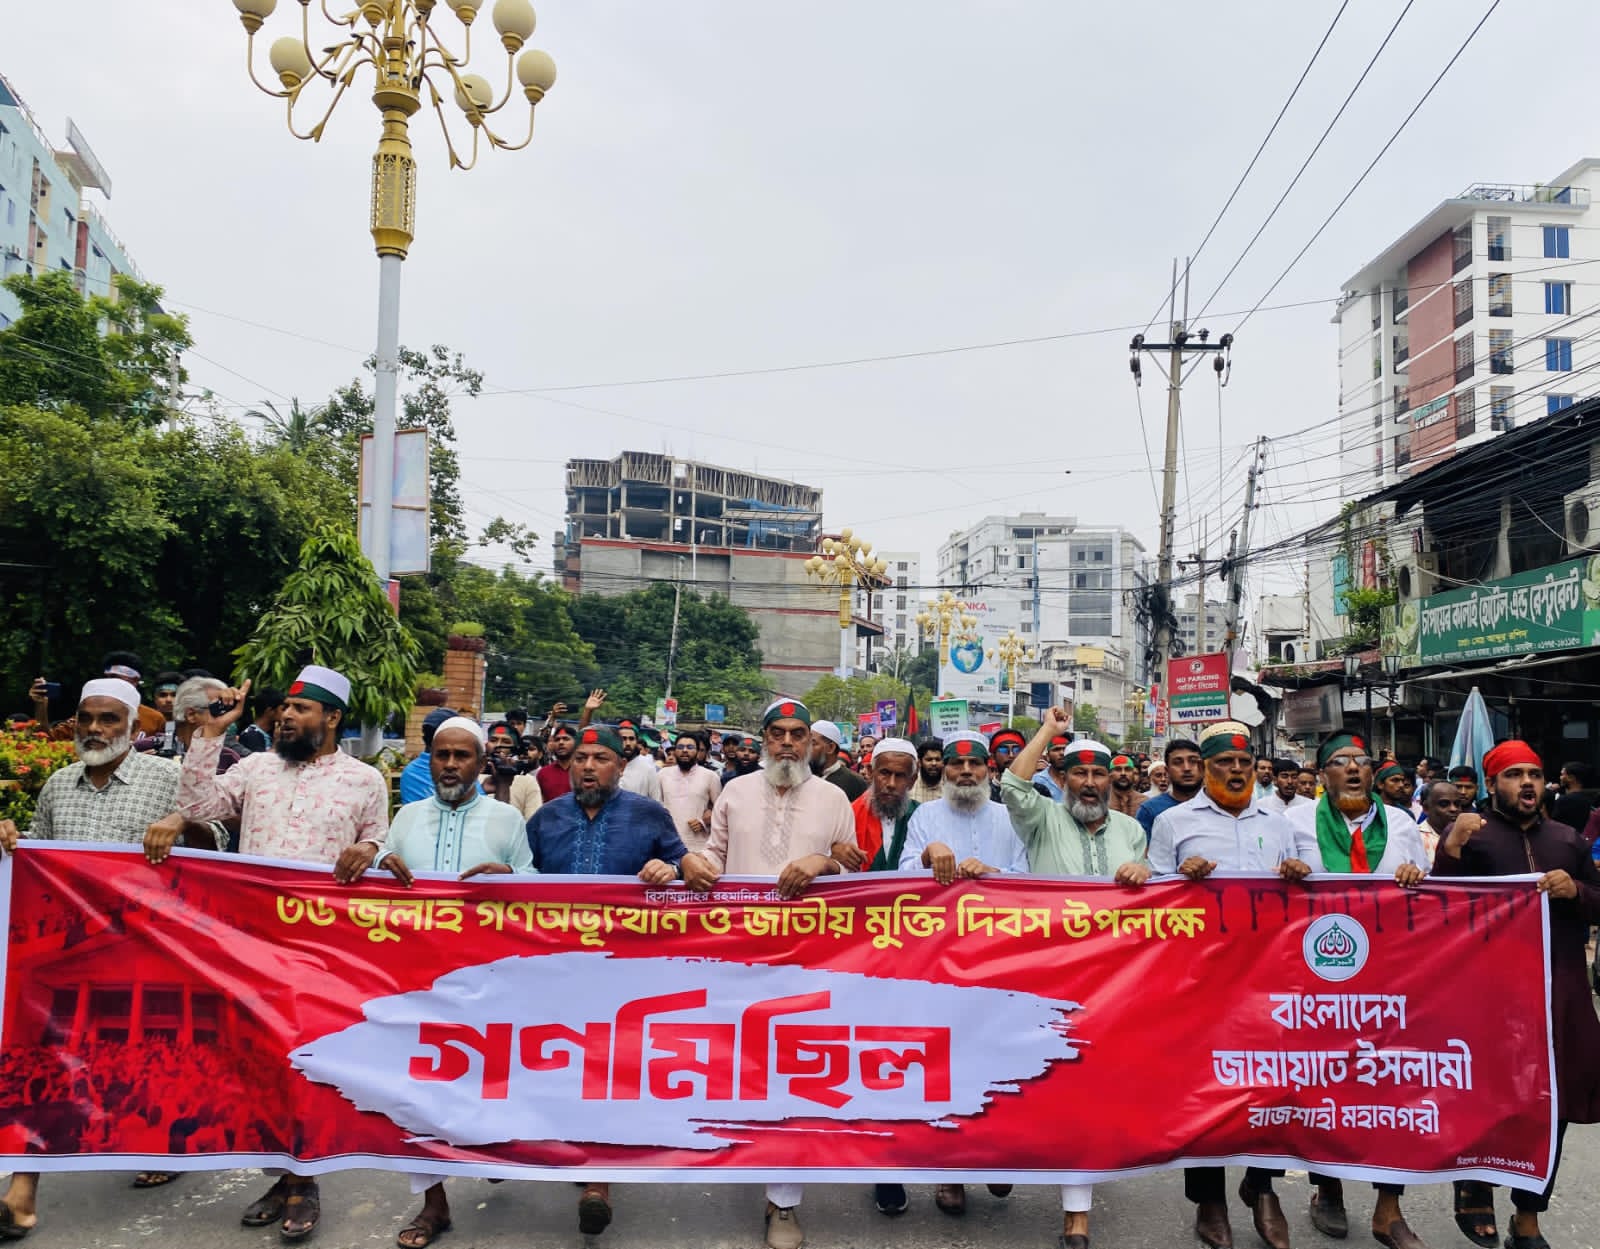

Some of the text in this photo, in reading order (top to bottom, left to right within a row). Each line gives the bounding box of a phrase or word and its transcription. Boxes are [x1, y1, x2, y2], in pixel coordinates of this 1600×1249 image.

[1452, 590, 1479, 630] কালাই
[1479, 586, 1509, 633] হোটেল
[1177, 708, 1222, 718] WALTON
[701, 907, 732, 935] ও
[743, 897, 855, 939] জাতীয়
[865, 893, 947, 949] মুক্তি
[956, 893, 1052, 938] দিবস
[1061, 898, 1206, 939] উপলক্ষে
[1269, 993, 1407, 1031] বাংলাদেশ
[408, 988, 952, 1109] গণমিছিল
[1212, 1038, 1472, 1092] জামায়াতে ইসলামী
[1247, 1097, 1439, 1134] রাজশাহী মহানগরী
